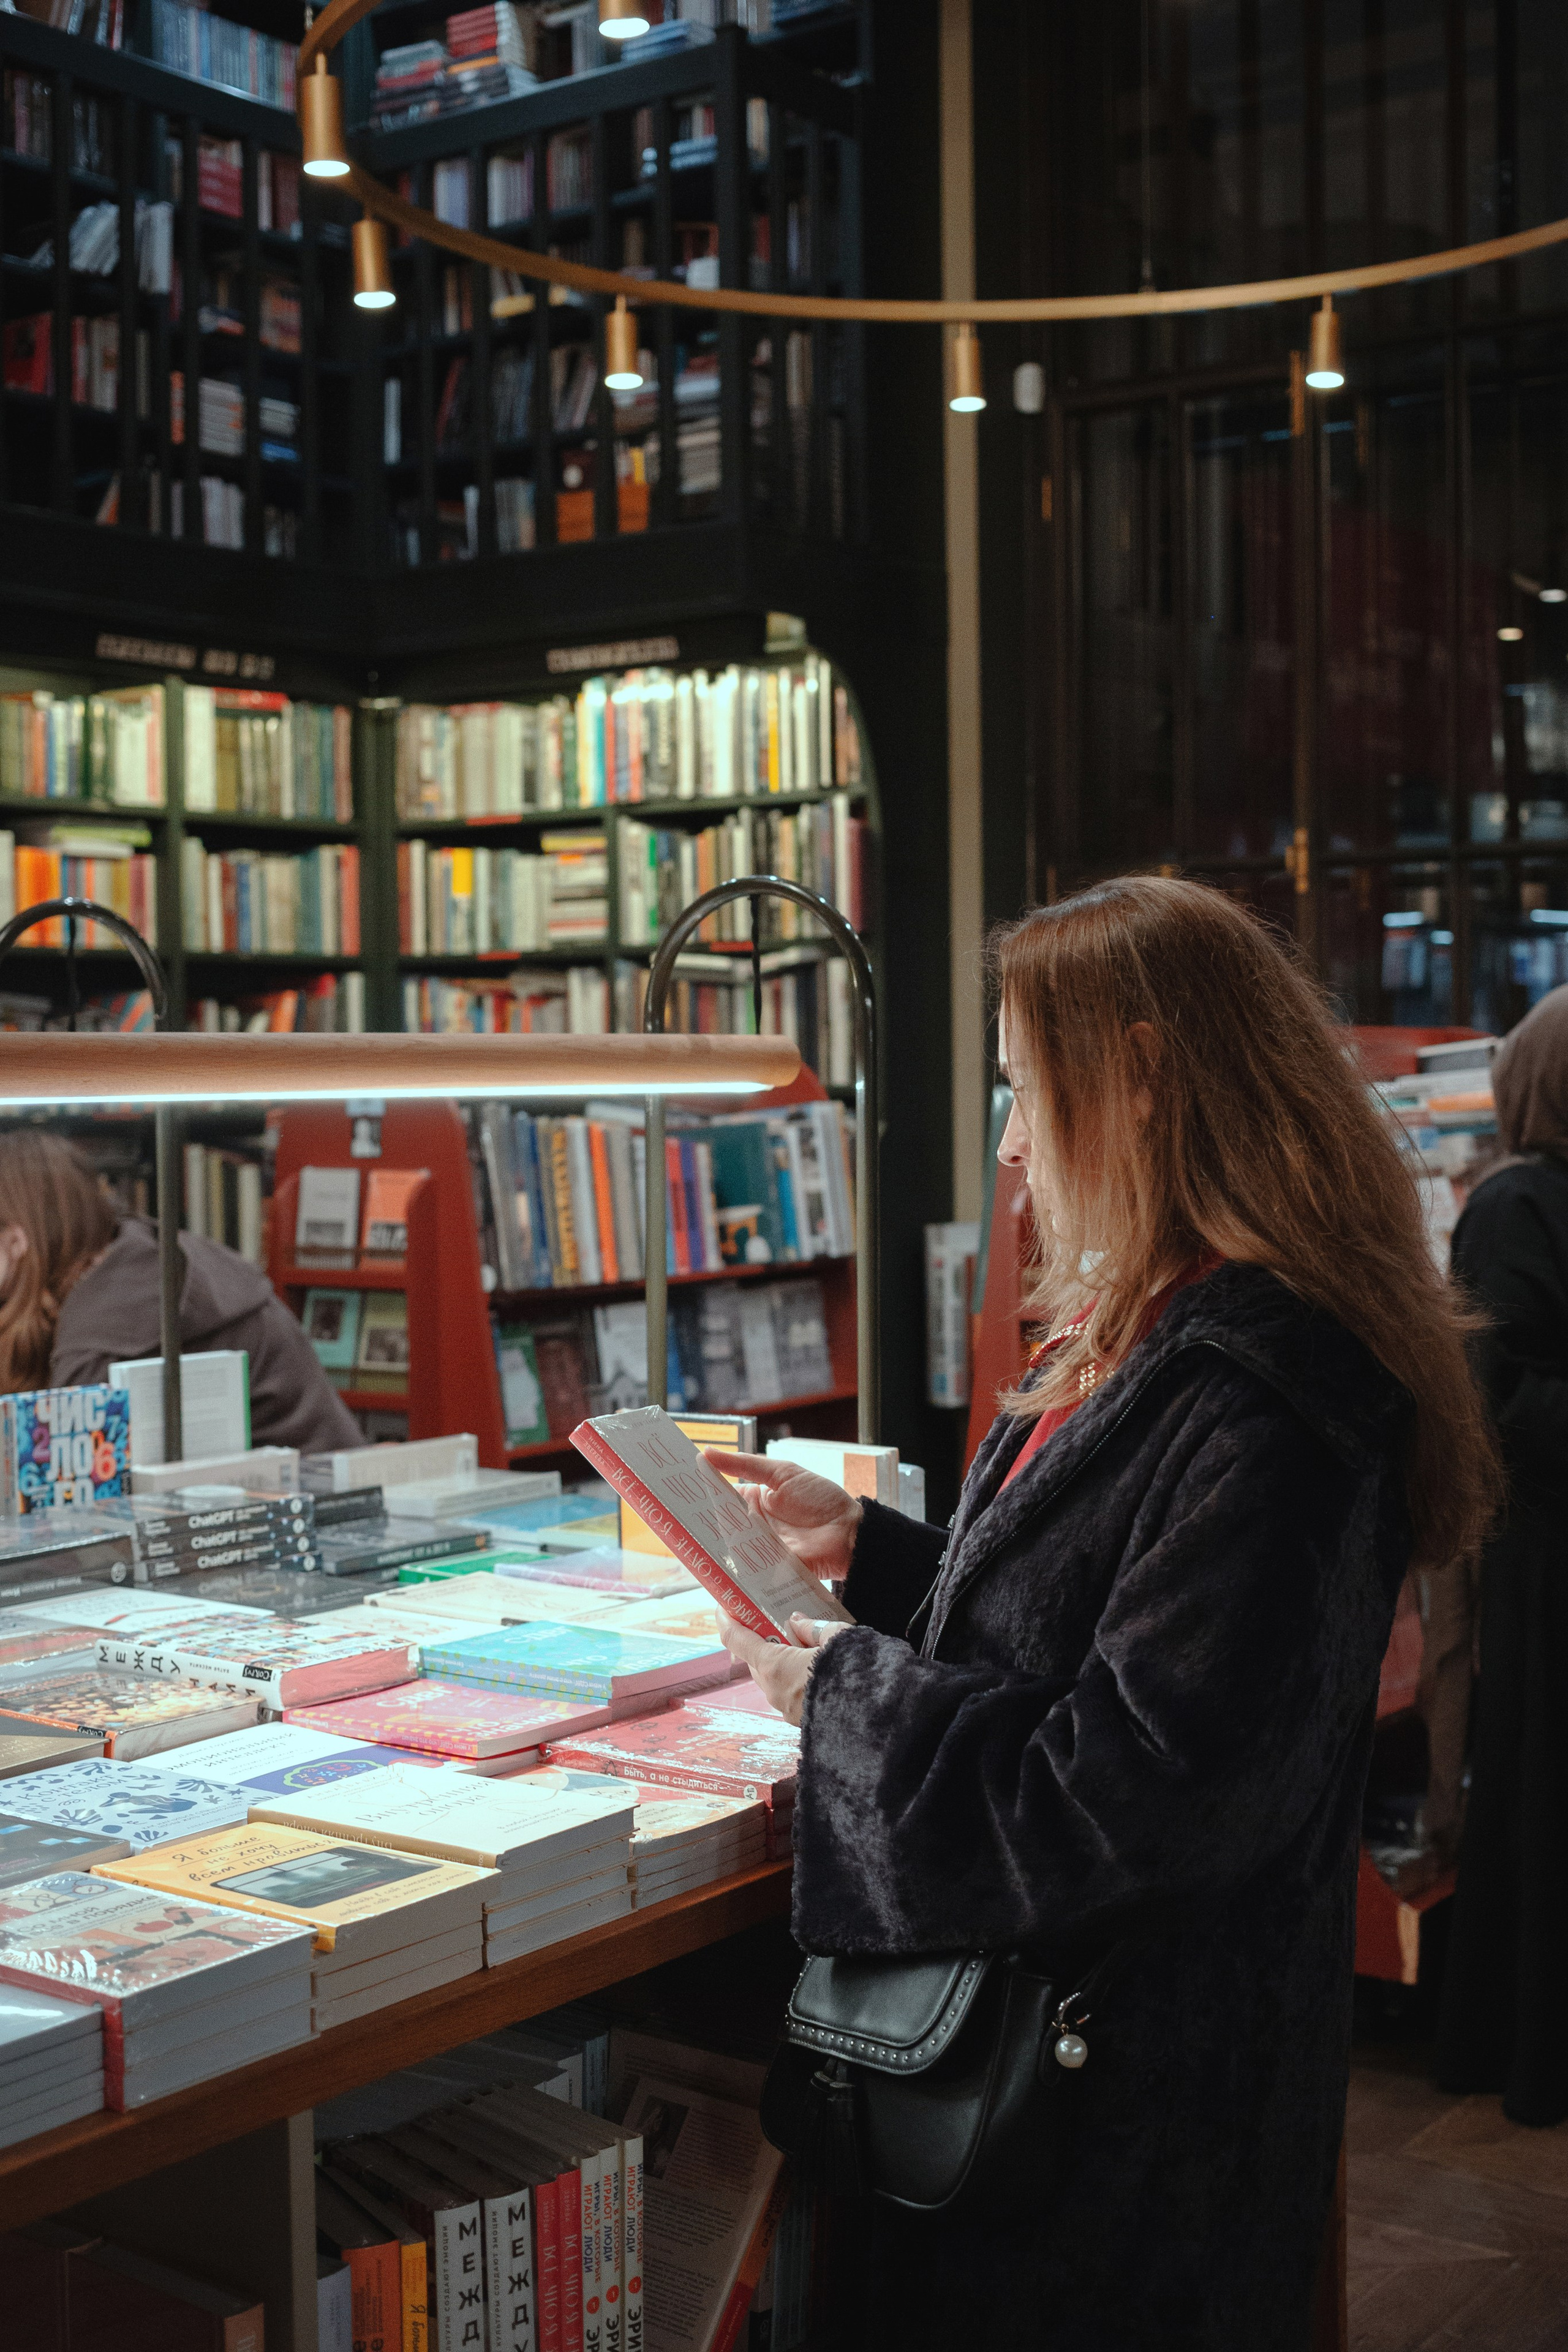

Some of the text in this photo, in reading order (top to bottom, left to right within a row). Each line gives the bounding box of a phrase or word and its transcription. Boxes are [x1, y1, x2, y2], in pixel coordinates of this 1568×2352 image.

[36, 1392, 107, 1434] ЧИС
[46, 1434, 94, 1482] ЛО
[584, 1442, 606, 1466] ЗВЕРЕВА
[589, 1436, 605, 1454] НИНА
[187, 1509, 236, 1529] ChatGPT
[190, 1530, 237, 1550] ChatGPT
[197, 1548, 243, 1569] ChatGPT
[17, 1775, 114, 1800] Контакт
[624, 1765, 718, 1792] Быть, а не стыдиться
[355, 1780, 496, 1822] Внутренняя
[418, 1793, 488, 1816] опора
[197, 1836, 261, 1856] больше
[207, 1842, 279, 1865] не хочу
[188, 1839, 336, 1883] всем нравиться
[81, 1894, 159, 1921] порядке
[603, 2174, 612, 2263] ИГРАЮТ ЛЮДИ
[626, 2165, 636, 2253] ИГРАЮТ ЛЮДИ
[583, 2184, 594, 2274] ИГРАЮТ ЛЮДИ
